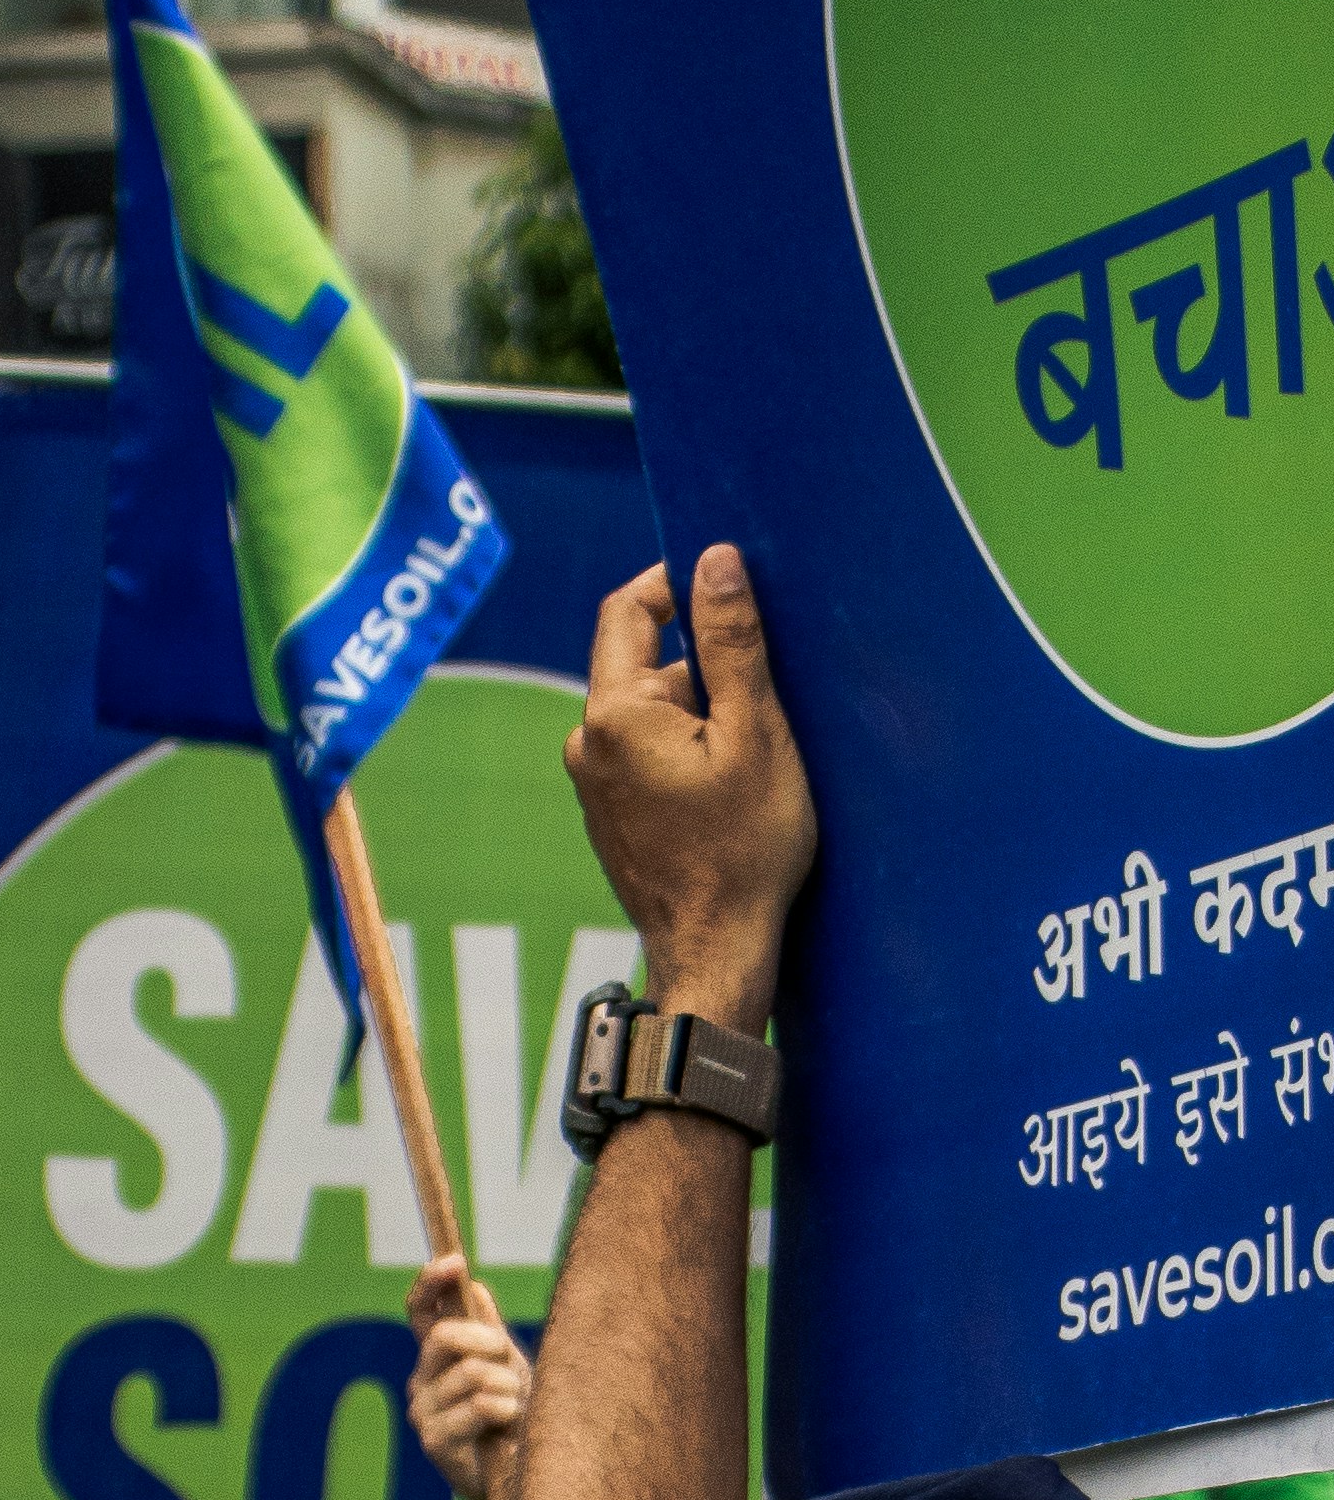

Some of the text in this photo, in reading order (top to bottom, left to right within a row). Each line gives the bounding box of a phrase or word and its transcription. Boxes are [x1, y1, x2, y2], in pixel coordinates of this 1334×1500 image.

[1032, 849, 1169, 1004] अभी
[41, 906, 649, 1271] SAV
[1017, 1057, 1152, 1191] आइये
[1169, 1030, 1251, 1167] इसे
